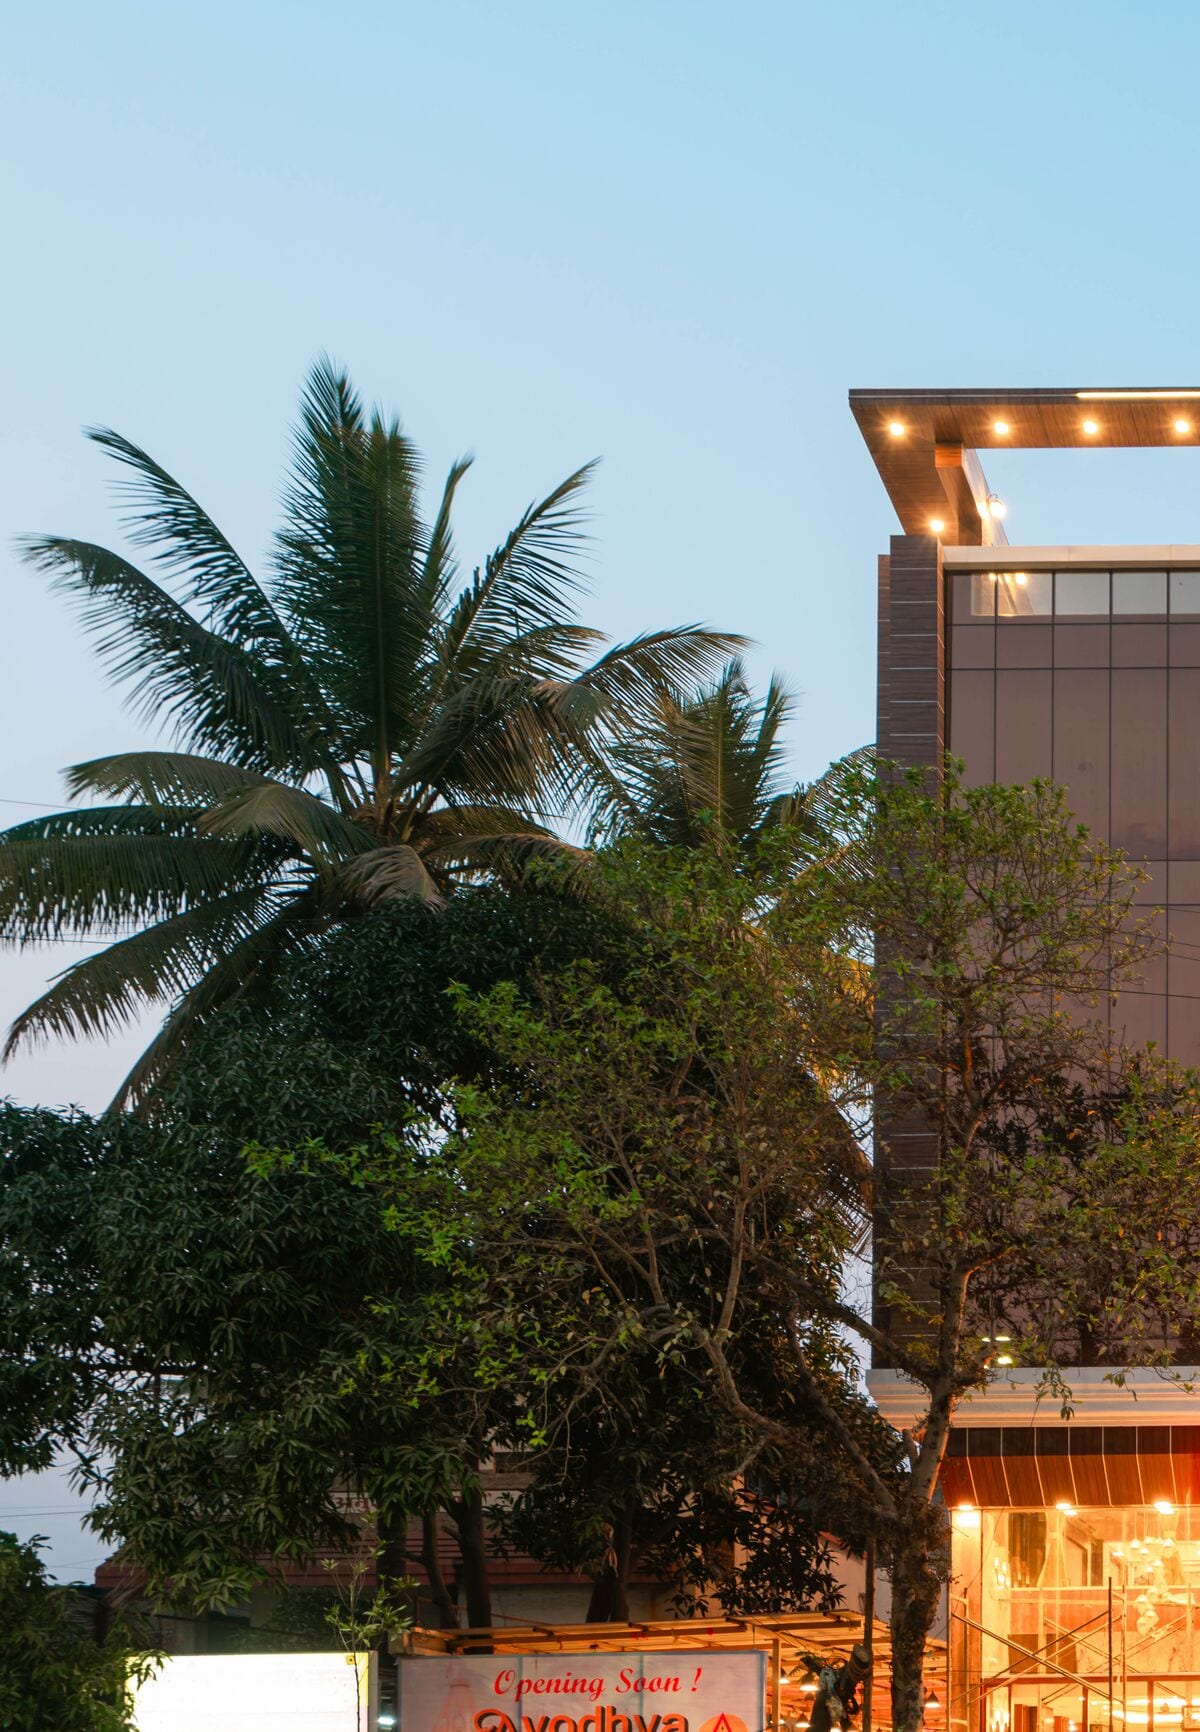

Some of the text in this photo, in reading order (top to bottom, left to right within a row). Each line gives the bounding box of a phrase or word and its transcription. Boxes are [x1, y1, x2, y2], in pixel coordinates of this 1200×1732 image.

[494, 1667, 703, 1702] Opening Soon !
